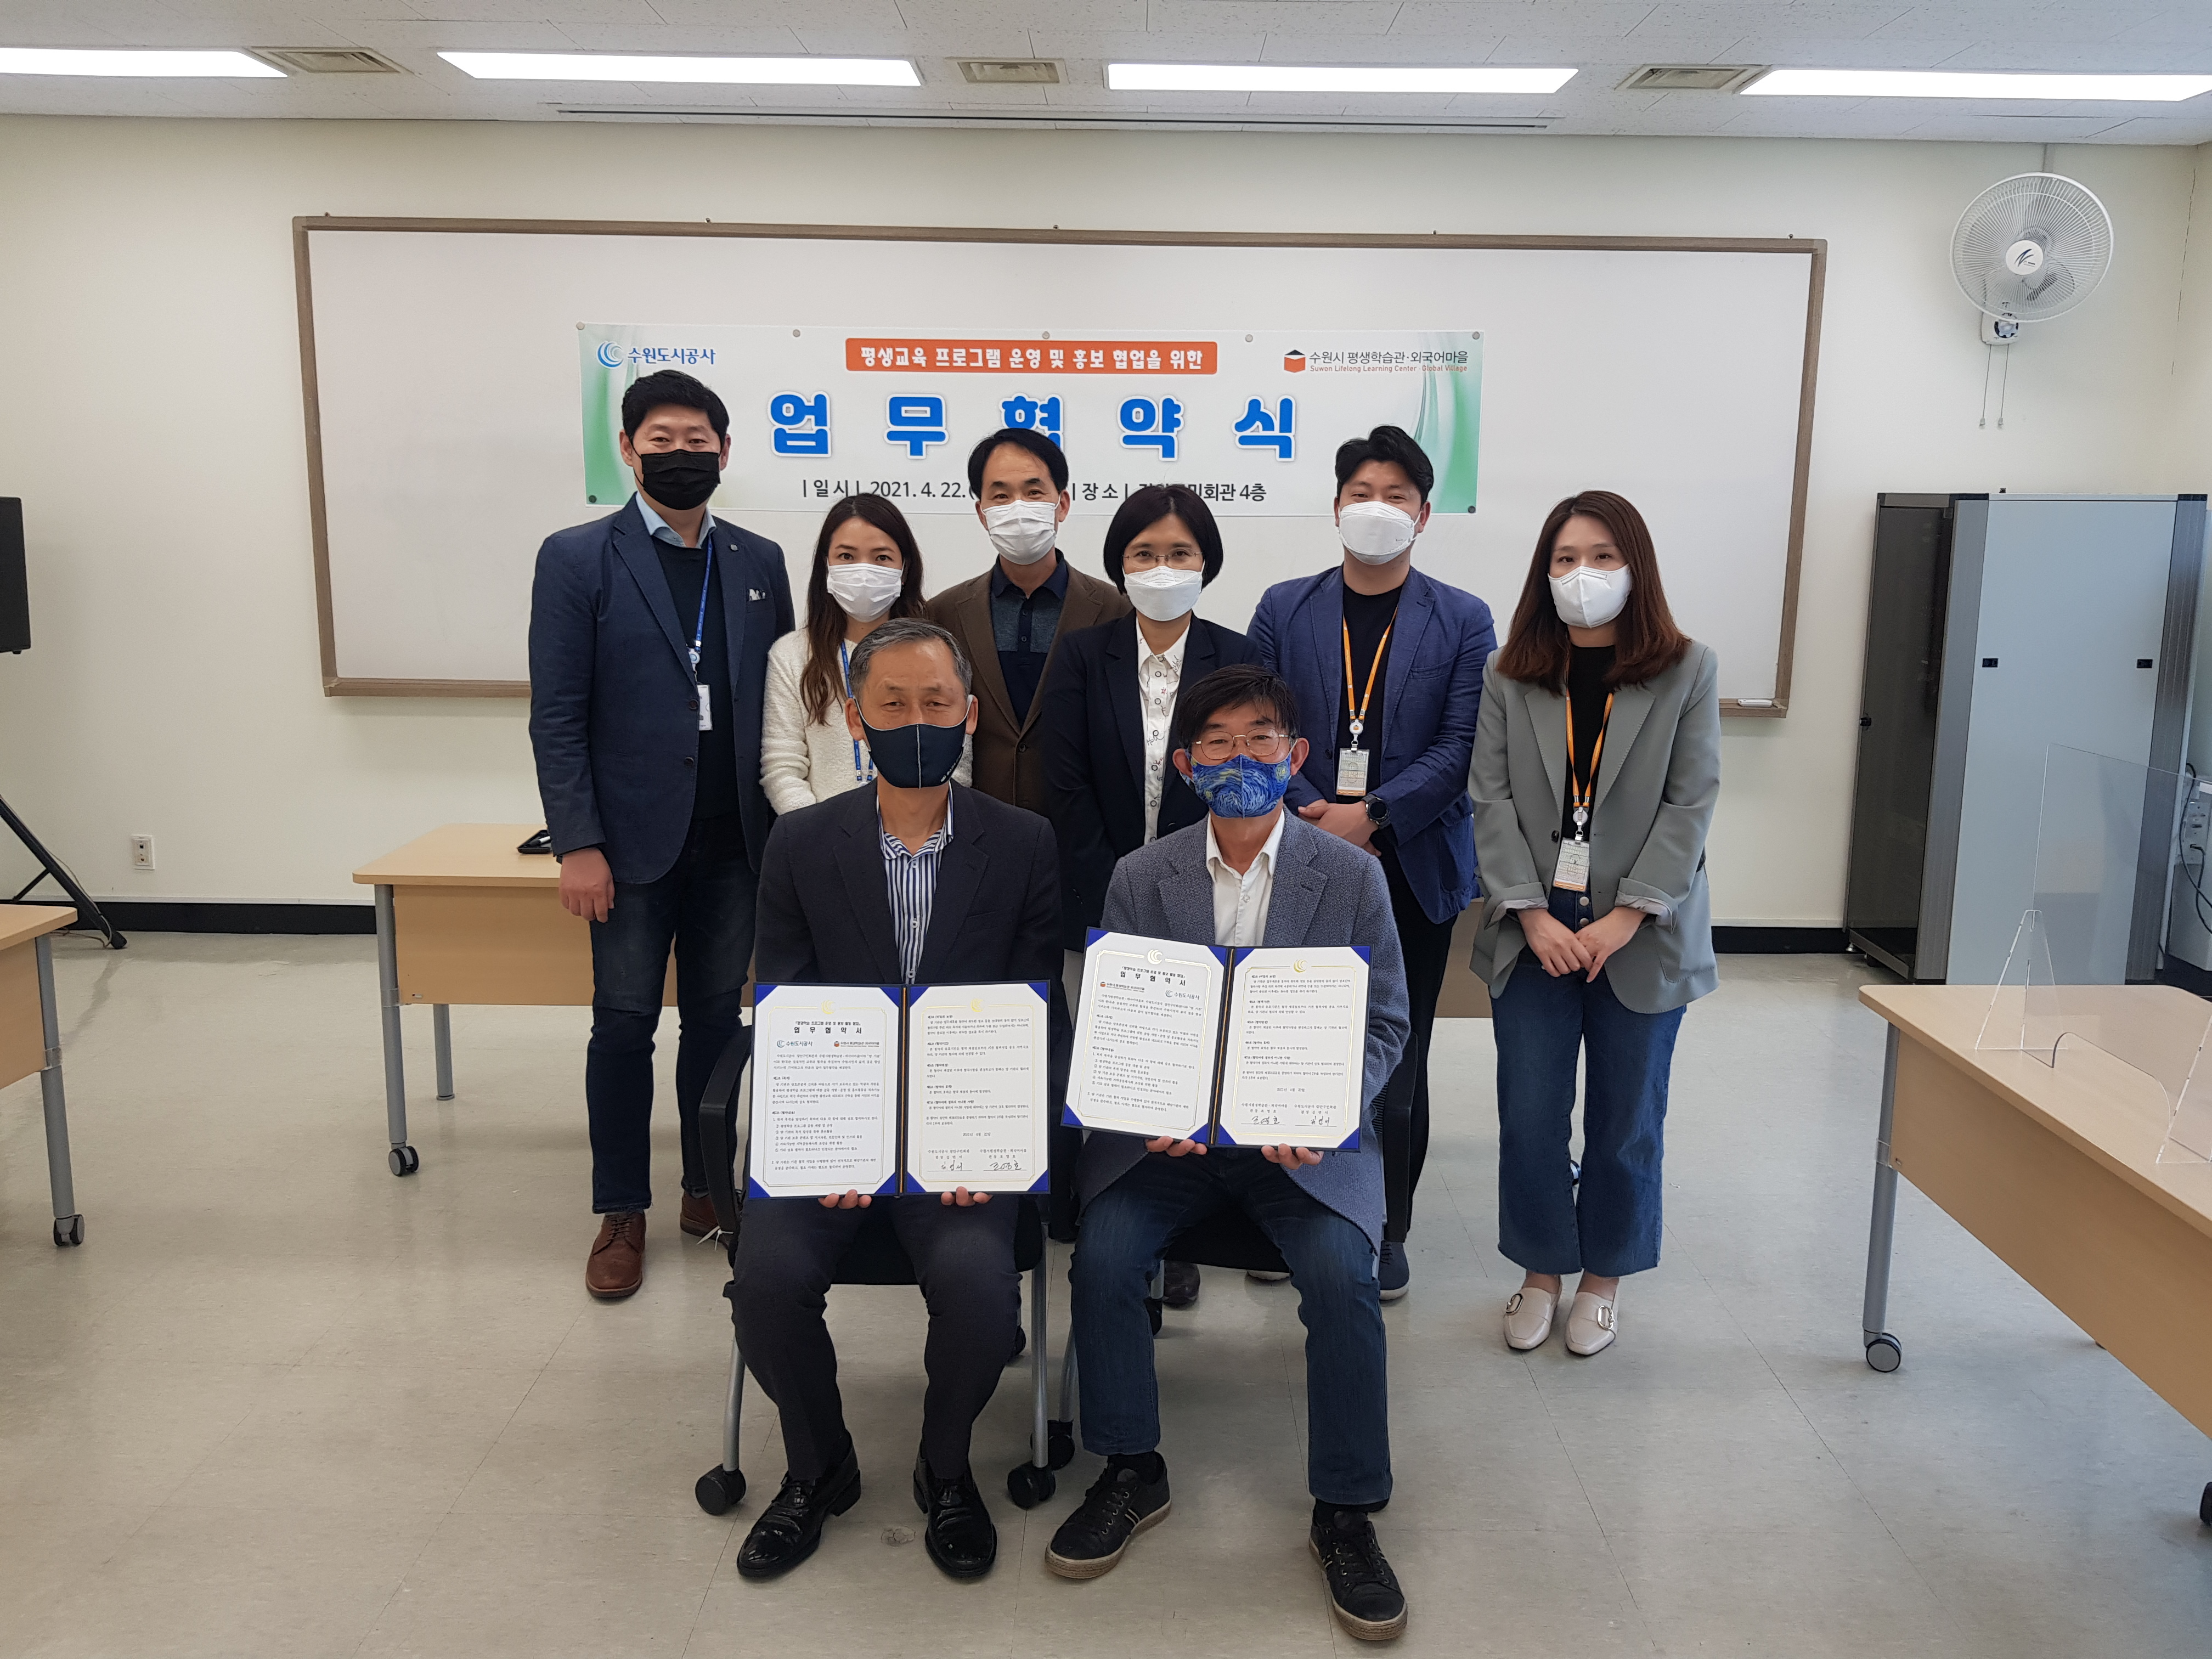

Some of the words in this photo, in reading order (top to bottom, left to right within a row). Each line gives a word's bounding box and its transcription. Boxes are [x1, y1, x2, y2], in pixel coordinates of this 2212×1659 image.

[628, 347, 716, 365] 수원도시공사
[861, 347, 927, 367] 평생교육
[936, 348, 1001, 368] 프로그램
[1009, 348, 1041, 369] 운영
[1049, 349, 1064, 369] 및
[1073, 349, 1104, 370] 홍보
[1113, 349, 1161, 369] 협업을
[1170, 349, 1203, 370] 위한
[1309, 351, 1344, 364] 수원시
[1334, 365, 1361, 373] Lifelong
[1363, 365, 1393, 373] Learning
[1445, 365, 1468, 373] Village
[921, 482, 936, 498] 4.
[1239, 483, 1267, 502] 4층
